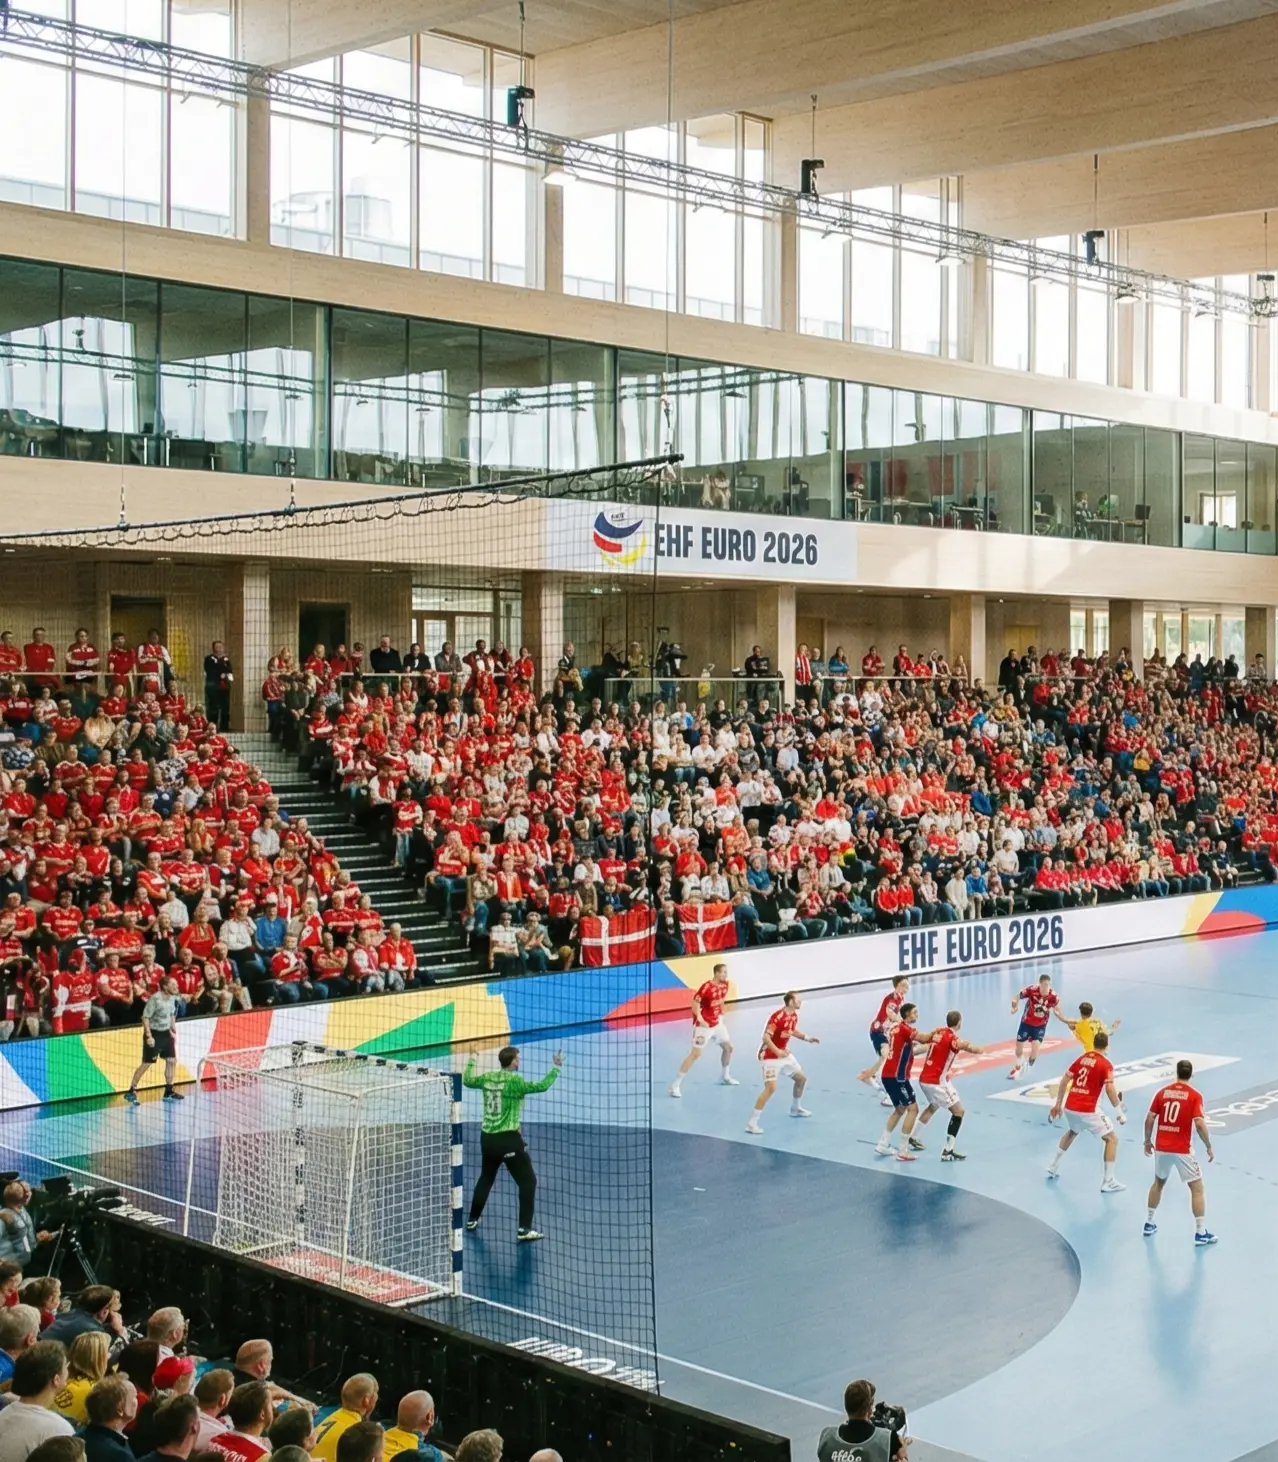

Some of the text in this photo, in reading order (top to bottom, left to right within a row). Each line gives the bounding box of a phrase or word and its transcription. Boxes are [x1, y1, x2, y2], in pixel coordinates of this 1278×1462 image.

[655, 523, 818, 566] EHF EURO 2026
[898, 914, 1064, 972] EHF EURO 2026
[1163, 1101, 1181, 1123] 10
